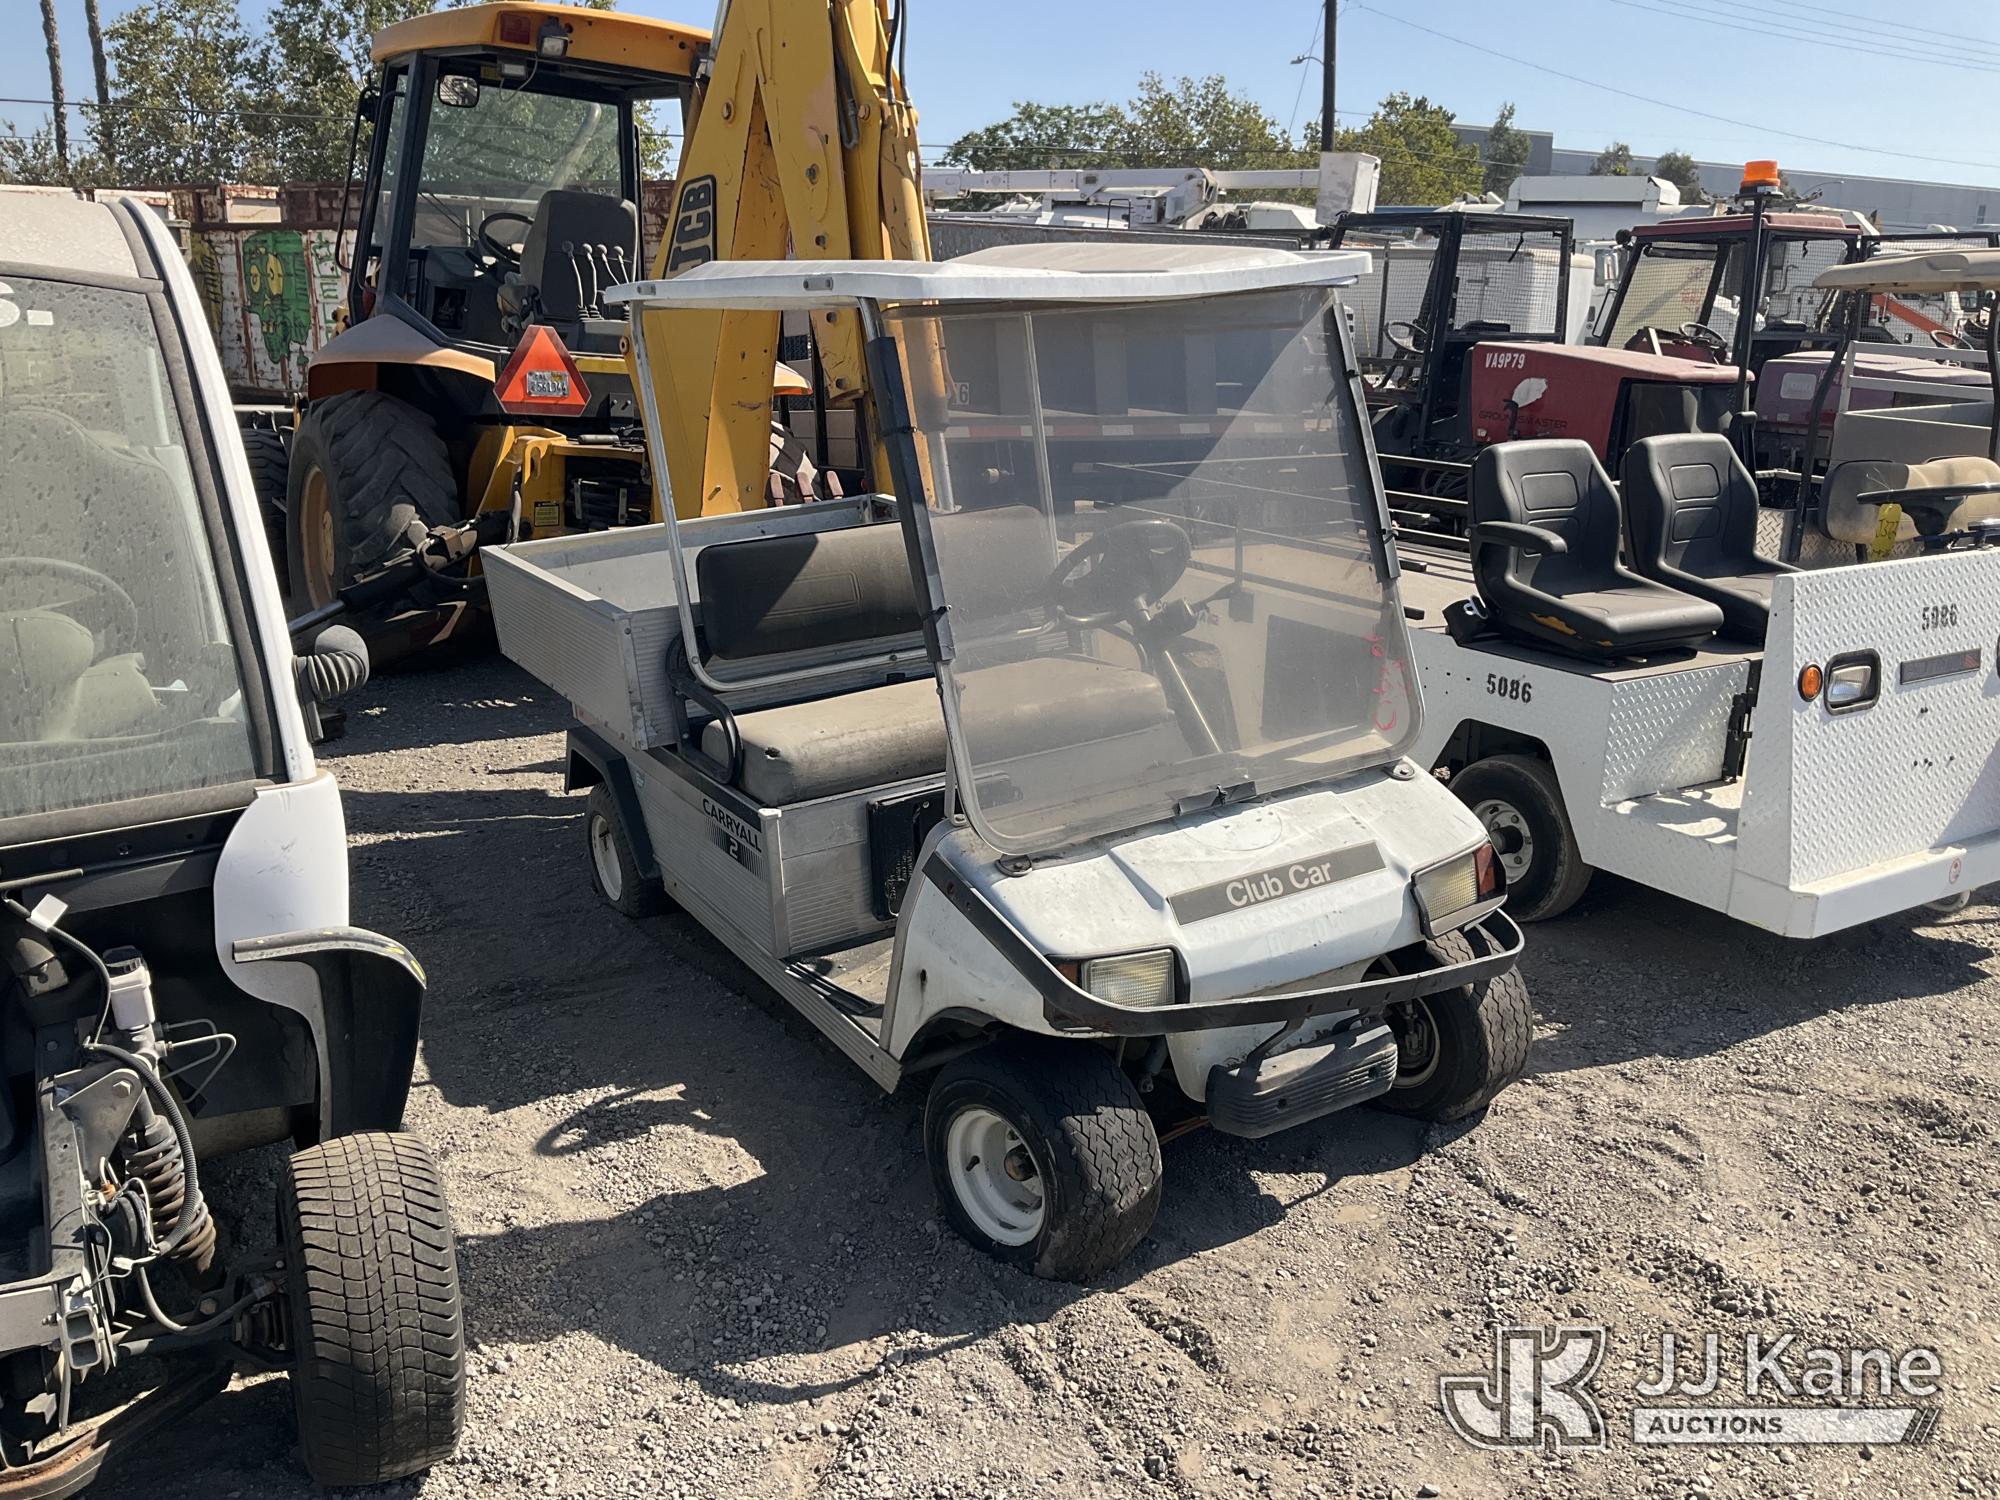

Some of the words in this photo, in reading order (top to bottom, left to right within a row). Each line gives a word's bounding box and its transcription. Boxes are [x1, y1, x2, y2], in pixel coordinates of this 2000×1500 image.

[669, 183, 712, 273] JCB
[1485, 353, 1526, 369] VA9P79
[1922, 603, 1958, 631] 5086
[1487, 673, 1532, 704] 5086
[702, 798, 762, 853] CARRYALL
[729, 837, 739, 860] 2
[1226, 873, 1284, 907] Club
[1288, 862, 1331, 889] Car
